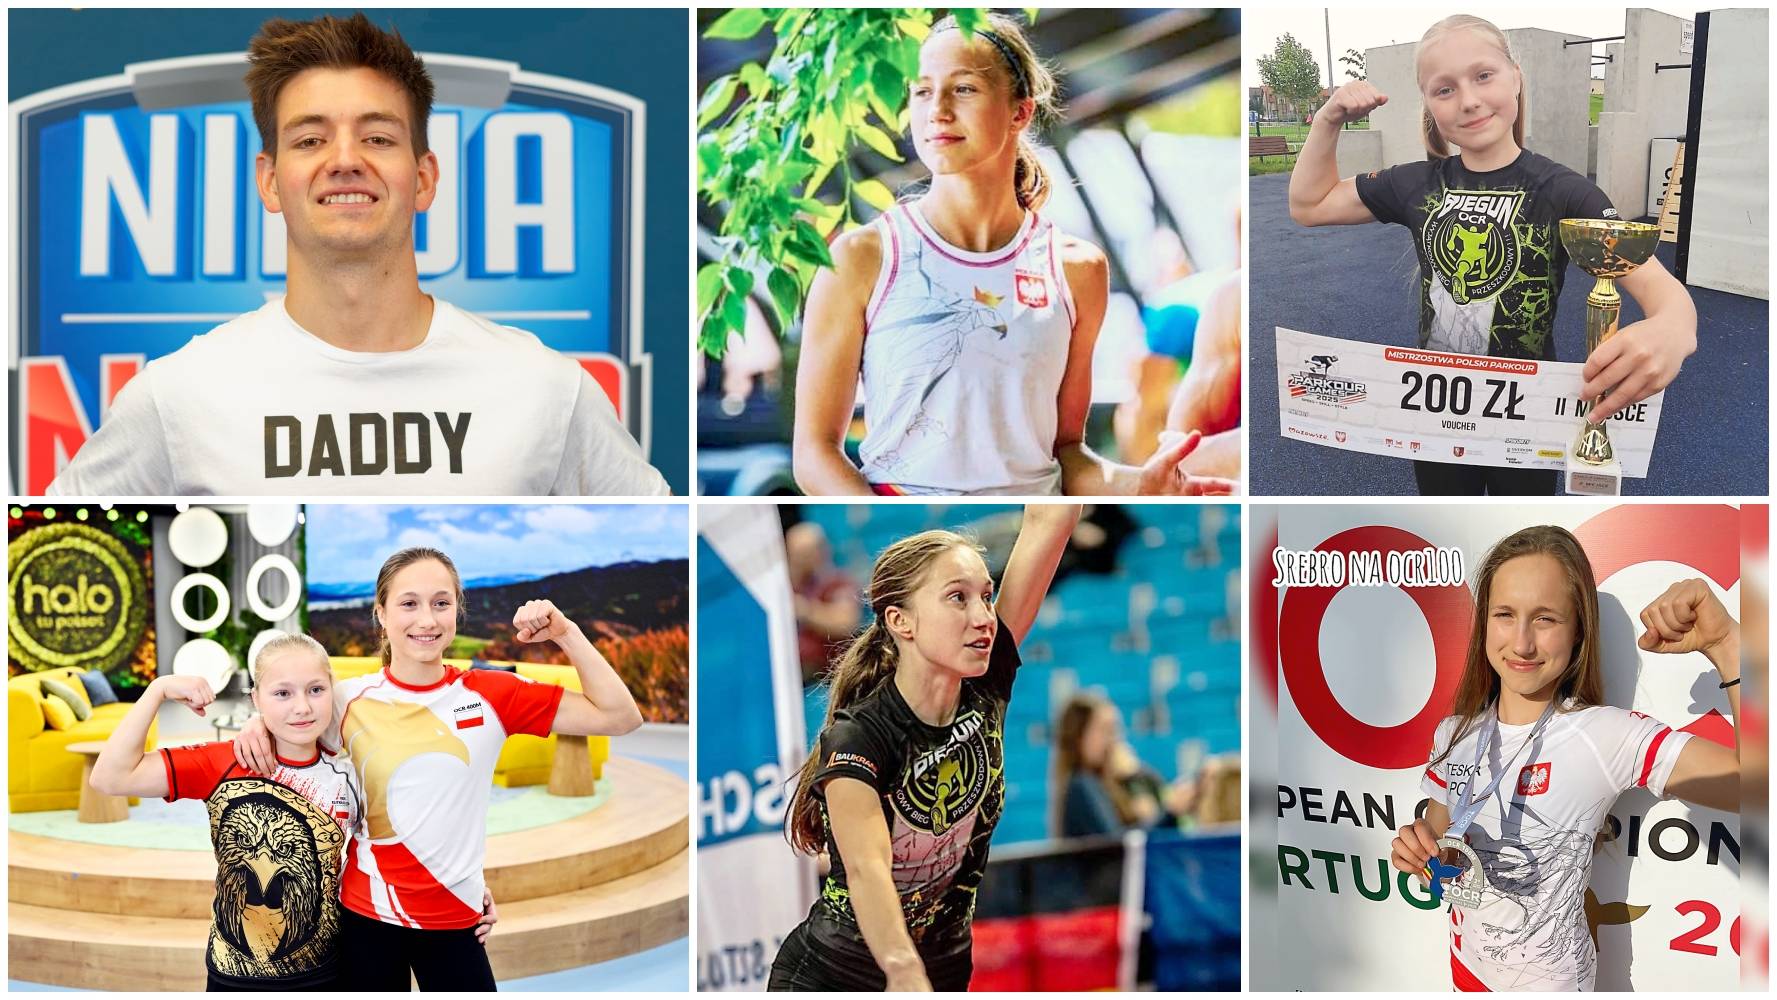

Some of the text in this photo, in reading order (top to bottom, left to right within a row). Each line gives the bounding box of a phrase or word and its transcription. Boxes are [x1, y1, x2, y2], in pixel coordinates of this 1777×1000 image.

[79, 114, 577, 277] NIJA
[1438, 193, 1518, 230] BIEGUN
[1458, 212, 1487, 225] OCR
[1436, 271, 1451, 286] BIEG
[1387, 350, 1535, 372] MISTRZOSTWA POLSKI PARKOUR
[1289, 375, 1367, 393] PARKOUR
[1308, 386, 1346, 397] GAMES
[1316, 395, 1338, 403] 2025
[1400, 371, 1526, 420] 200 ZŁ
[1555, 397, 1648, 422] II MSCE
[1441, 420, 1476, 431] VOUCHER
[264, 411, 472, 478] DADDY
[22, 574, 114, 614] halo
[911, 810, 930, 824] BIEG
[1452, 887, 1480, 902] OCR
